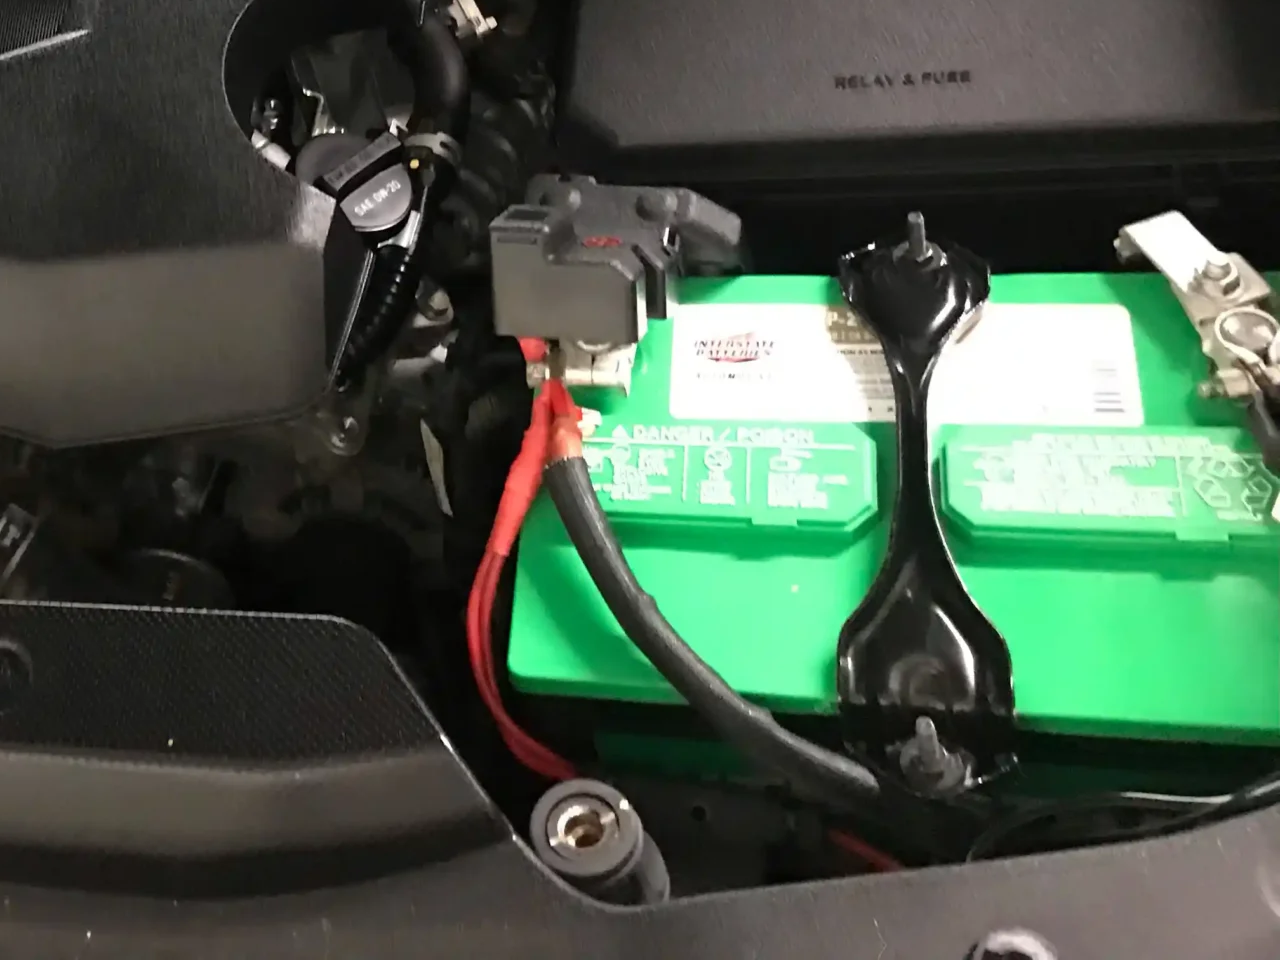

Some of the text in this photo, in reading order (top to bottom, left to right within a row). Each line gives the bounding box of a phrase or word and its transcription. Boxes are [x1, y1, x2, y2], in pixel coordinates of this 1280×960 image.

[834, 70, 971, 90] RELAY & FUSE
